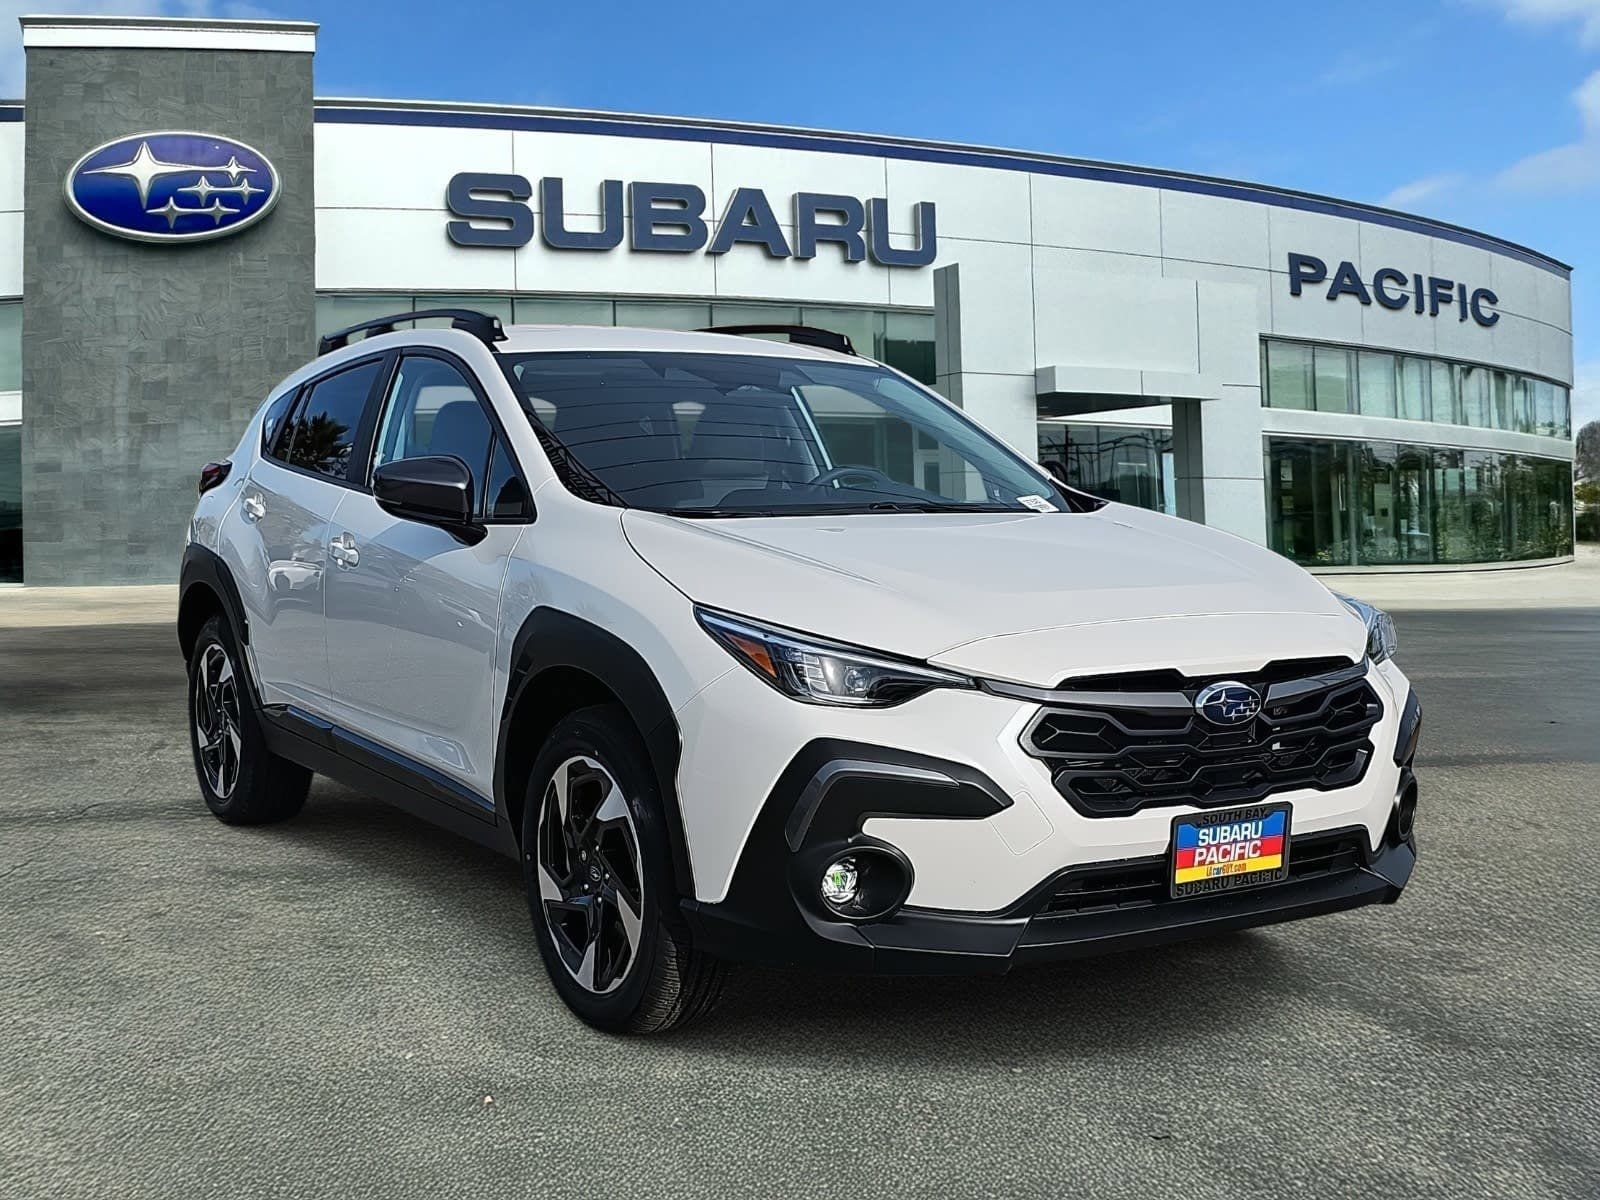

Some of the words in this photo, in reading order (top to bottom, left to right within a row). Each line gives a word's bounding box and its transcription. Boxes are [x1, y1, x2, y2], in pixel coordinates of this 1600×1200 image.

[447, 171, 937, 267] SUBARU
[1288, 252, 1500, 327] PACIFIC
[1202, 810, 1242, 825] SOUTH
[1245, 807, 1266, 820] BAY
[1198, 820, 1263, 847] SUBARU
[1194, 839, 1262, 868] PACIFIC
[1175, 877, 1230, 897] SUBARU
[1234, 870, 1283, 886] PACIFIC
